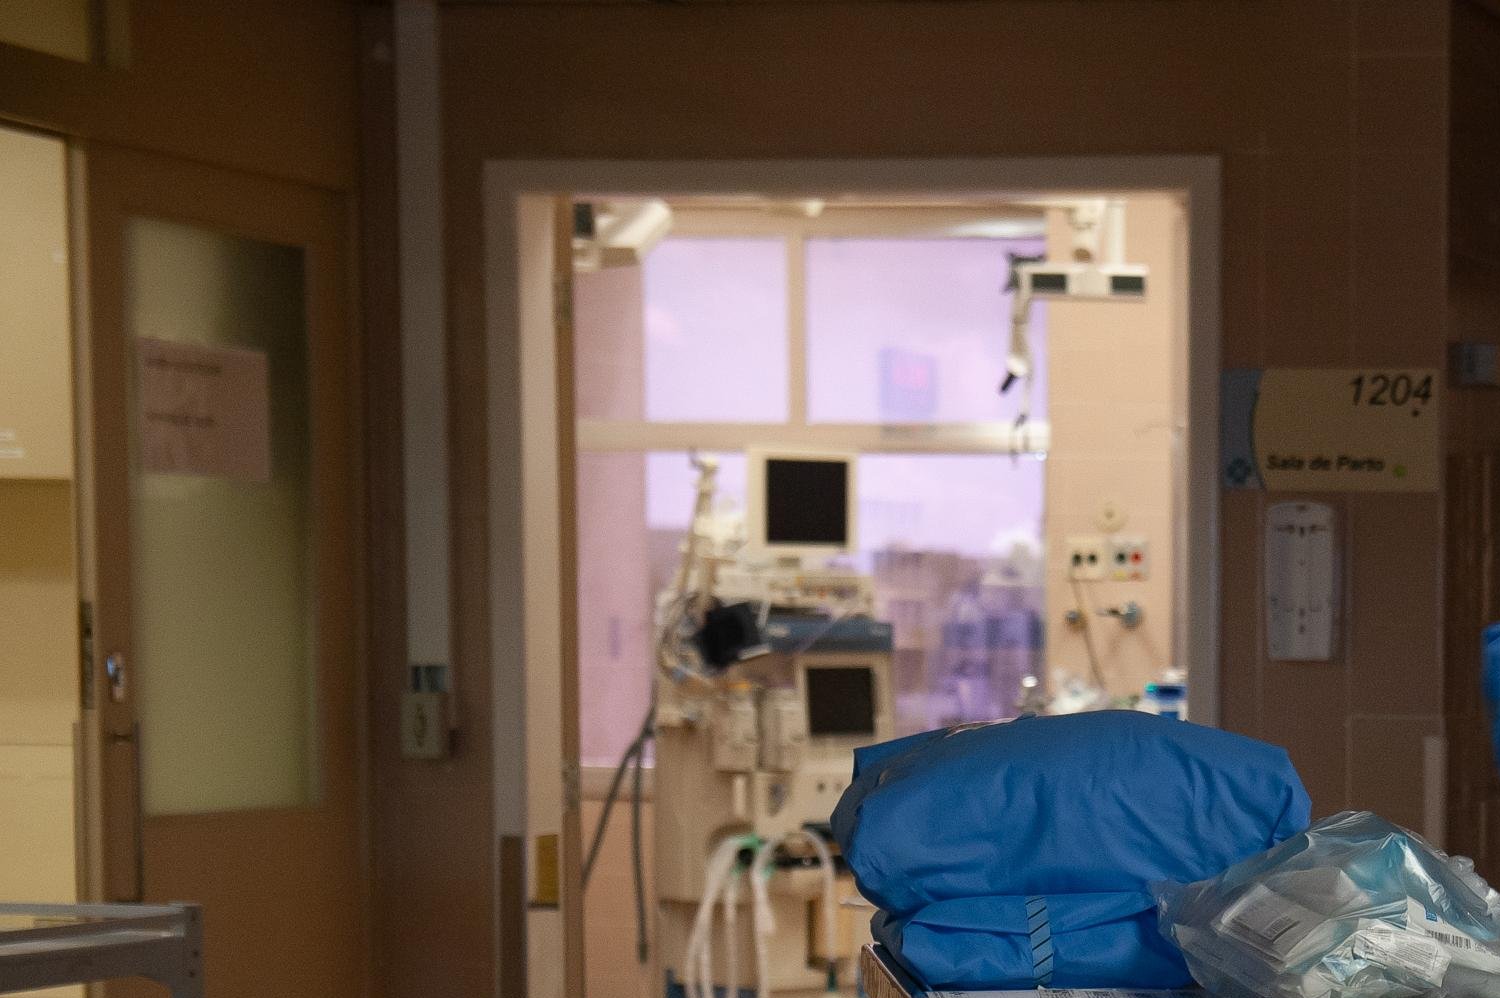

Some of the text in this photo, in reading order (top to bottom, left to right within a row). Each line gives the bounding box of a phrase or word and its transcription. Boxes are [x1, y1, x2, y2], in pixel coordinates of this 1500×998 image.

[1350, 374, 1434, 407] 1204
[1265, 455, 1387, 473] Sala de Parto
